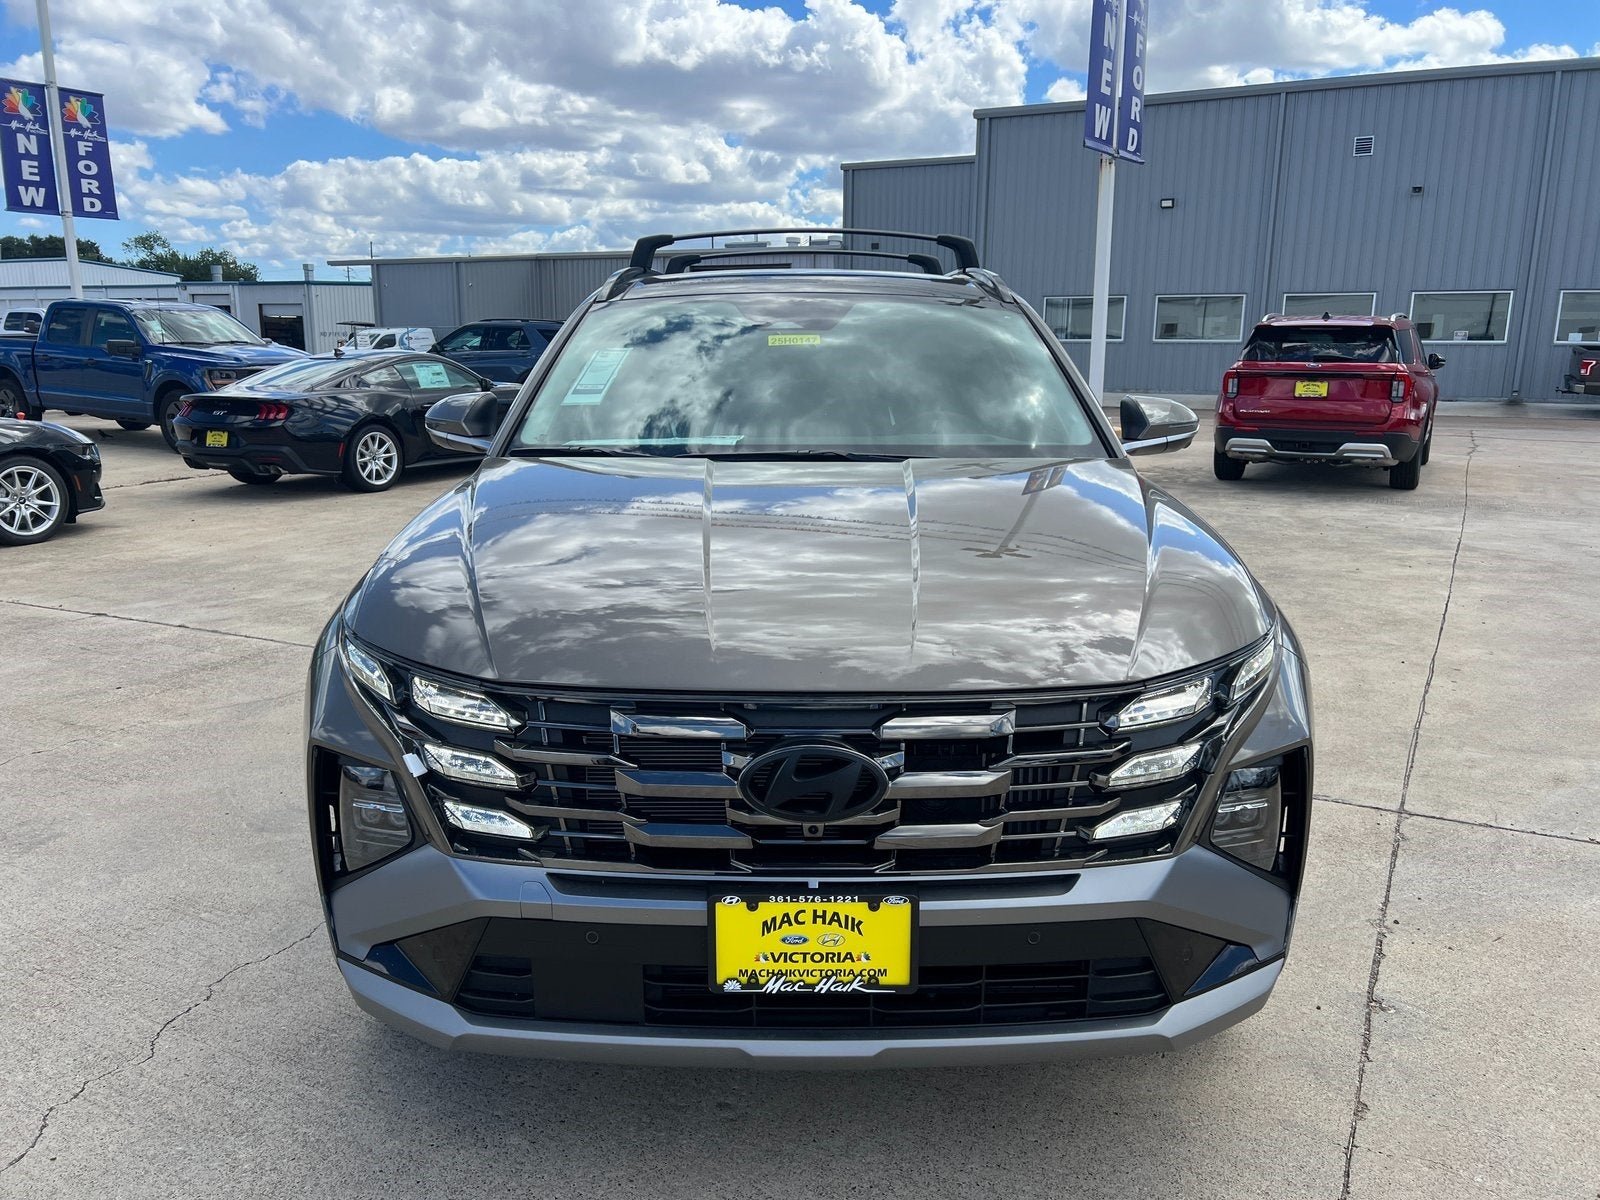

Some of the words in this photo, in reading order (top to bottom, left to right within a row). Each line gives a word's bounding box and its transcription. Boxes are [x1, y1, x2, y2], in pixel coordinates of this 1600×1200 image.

[1095, 12, 1116, 140] NEW
[1127, 32, 1144, 152] FORD
[16, 133, 46, 207] NEW
[77, 141, 102, 212] FORD
[769, 895, 859, 903] 361-576-1221
[885, 896, 907, 905] Ford
[761, 909, 806, 937] MAC
[812, 909, 864, 937] HAIK
[782, 935, 807, 945] Ford
[769, 952, 856, 964] VICTORIA
[738, 968, 888, 978] MACHAIKVICTORIA.COM
[761, 975, 812, 994] Mac
[814, 975, 872, 994] Haik
